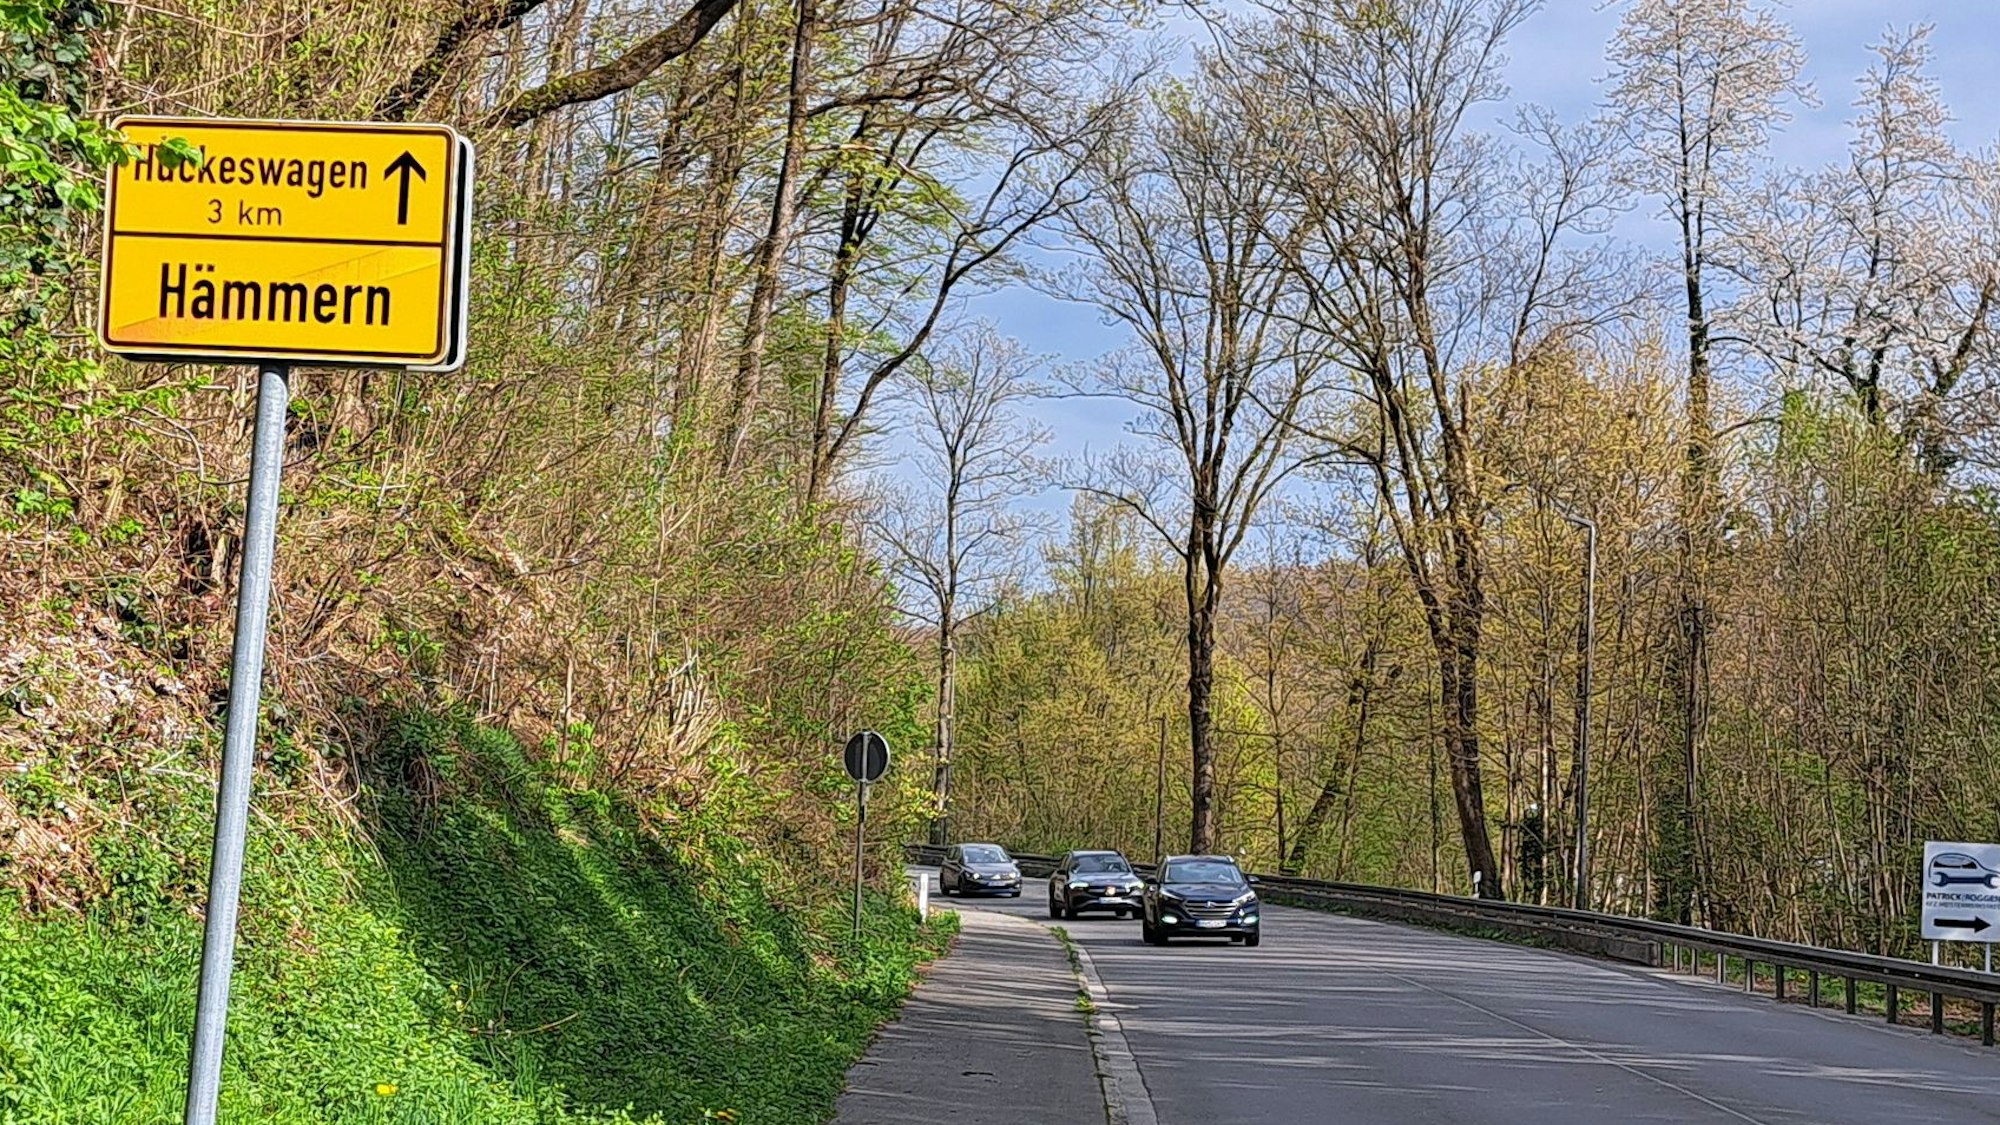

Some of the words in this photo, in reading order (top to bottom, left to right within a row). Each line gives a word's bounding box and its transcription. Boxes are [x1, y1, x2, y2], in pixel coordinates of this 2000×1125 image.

[208, 199, 222, 224] 3
[239, 200, 282, 226] km
[159, 262, 391, 326] Hämmern
[1926, 892, 1962, 900] PATRICK
